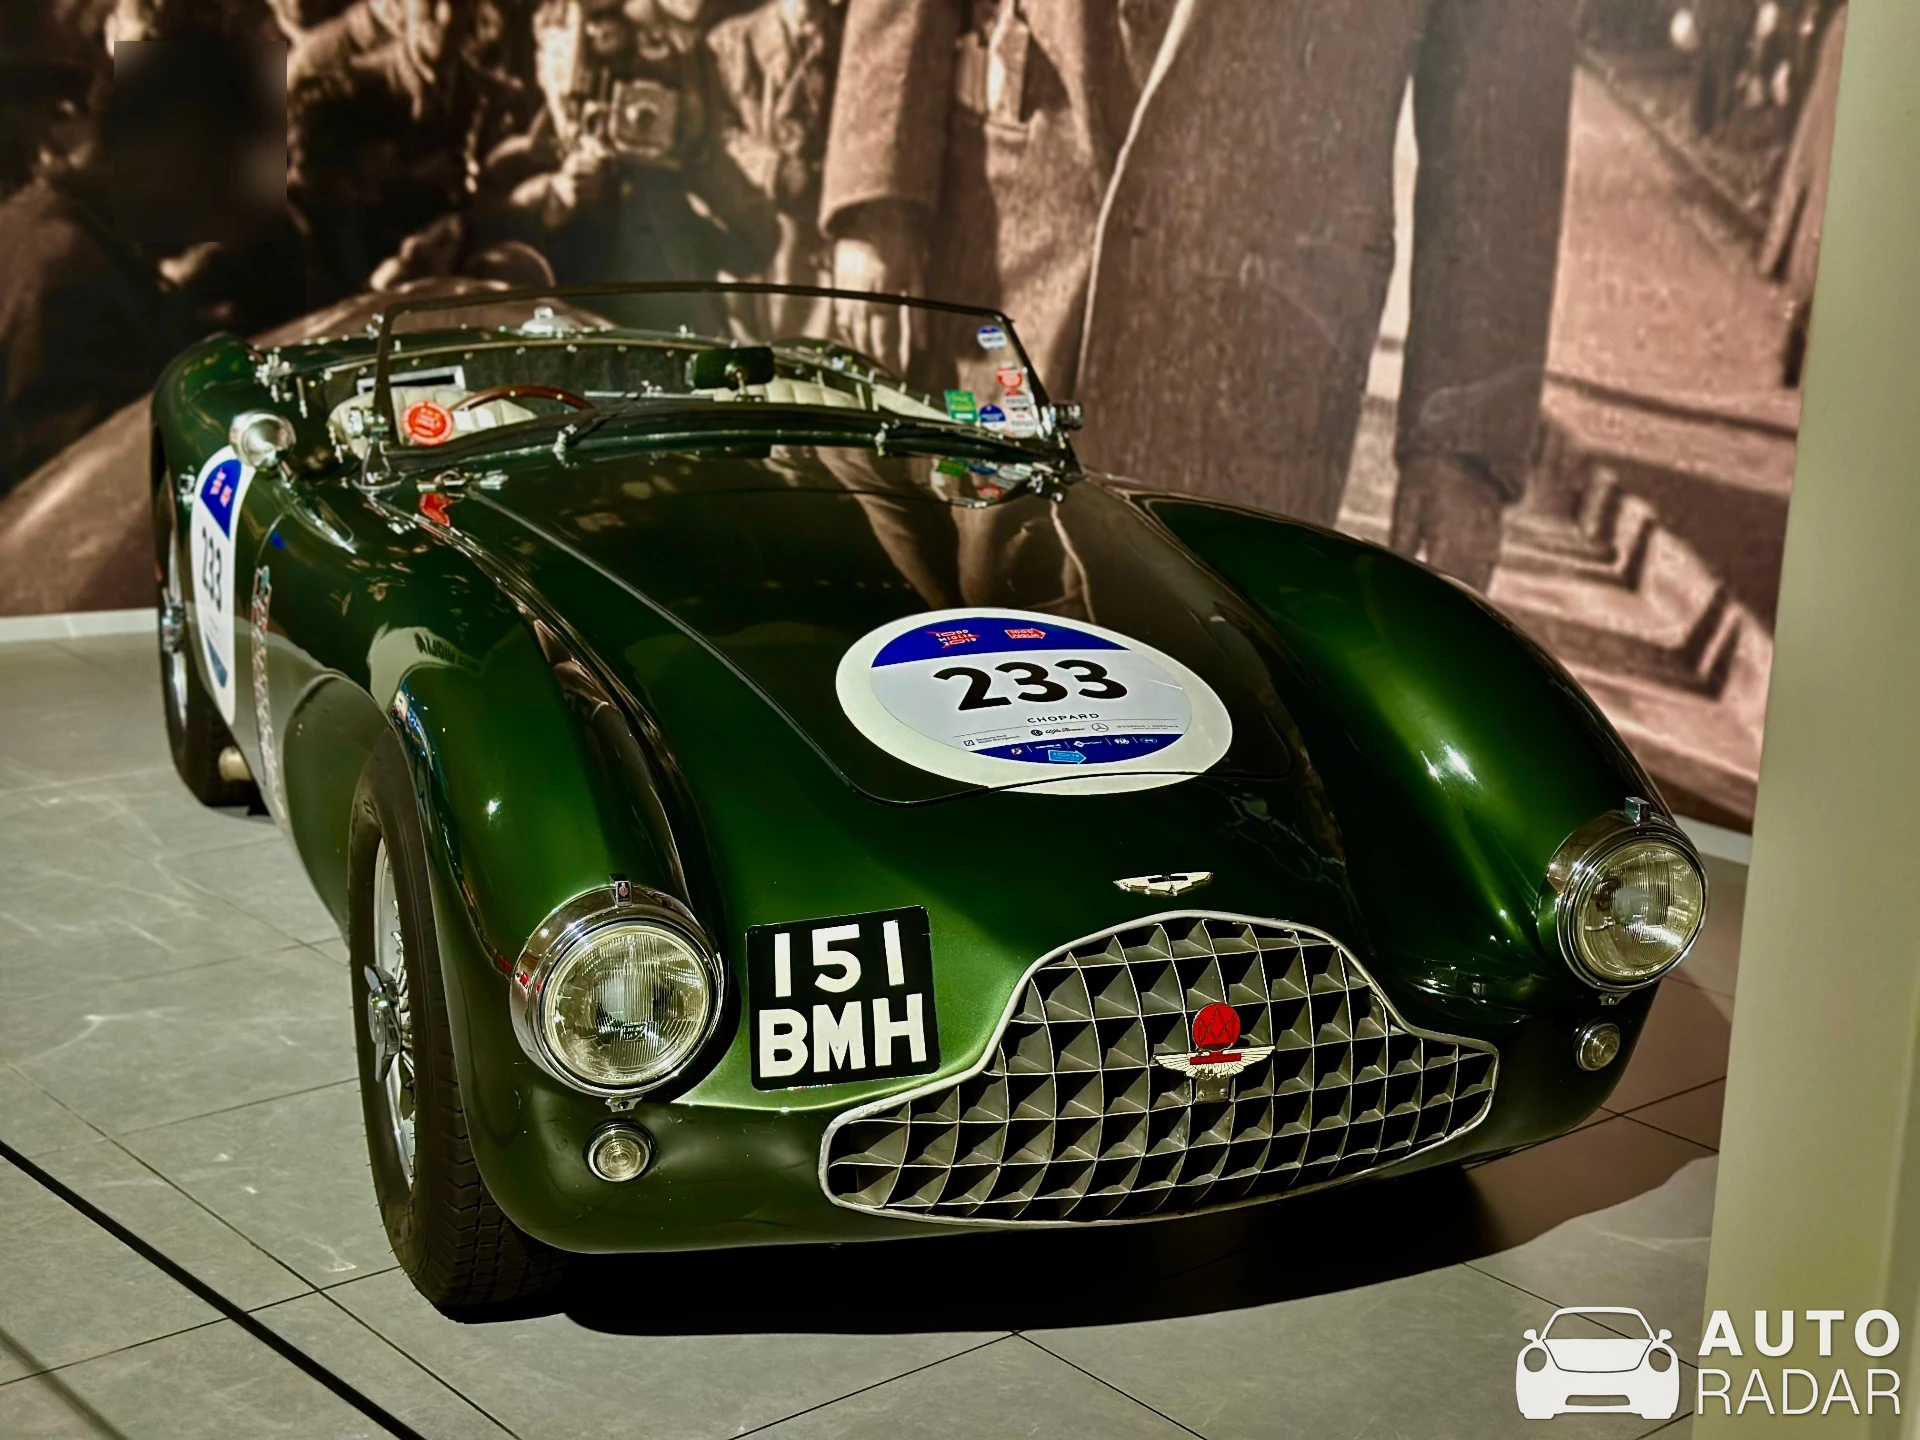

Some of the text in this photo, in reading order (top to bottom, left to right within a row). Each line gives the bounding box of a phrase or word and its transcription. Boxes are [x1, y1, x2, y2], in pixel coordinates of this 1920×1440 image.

[202, 526, 222, 613] 233
[938, 633, 974, 642] MIGLIA
[933, 659, 1128, 711] 233
[1027, 713, 1100, 724] CHOPARD
[774, 919, 905, 998] 151
[759, 993, 927, 1078] BMH
